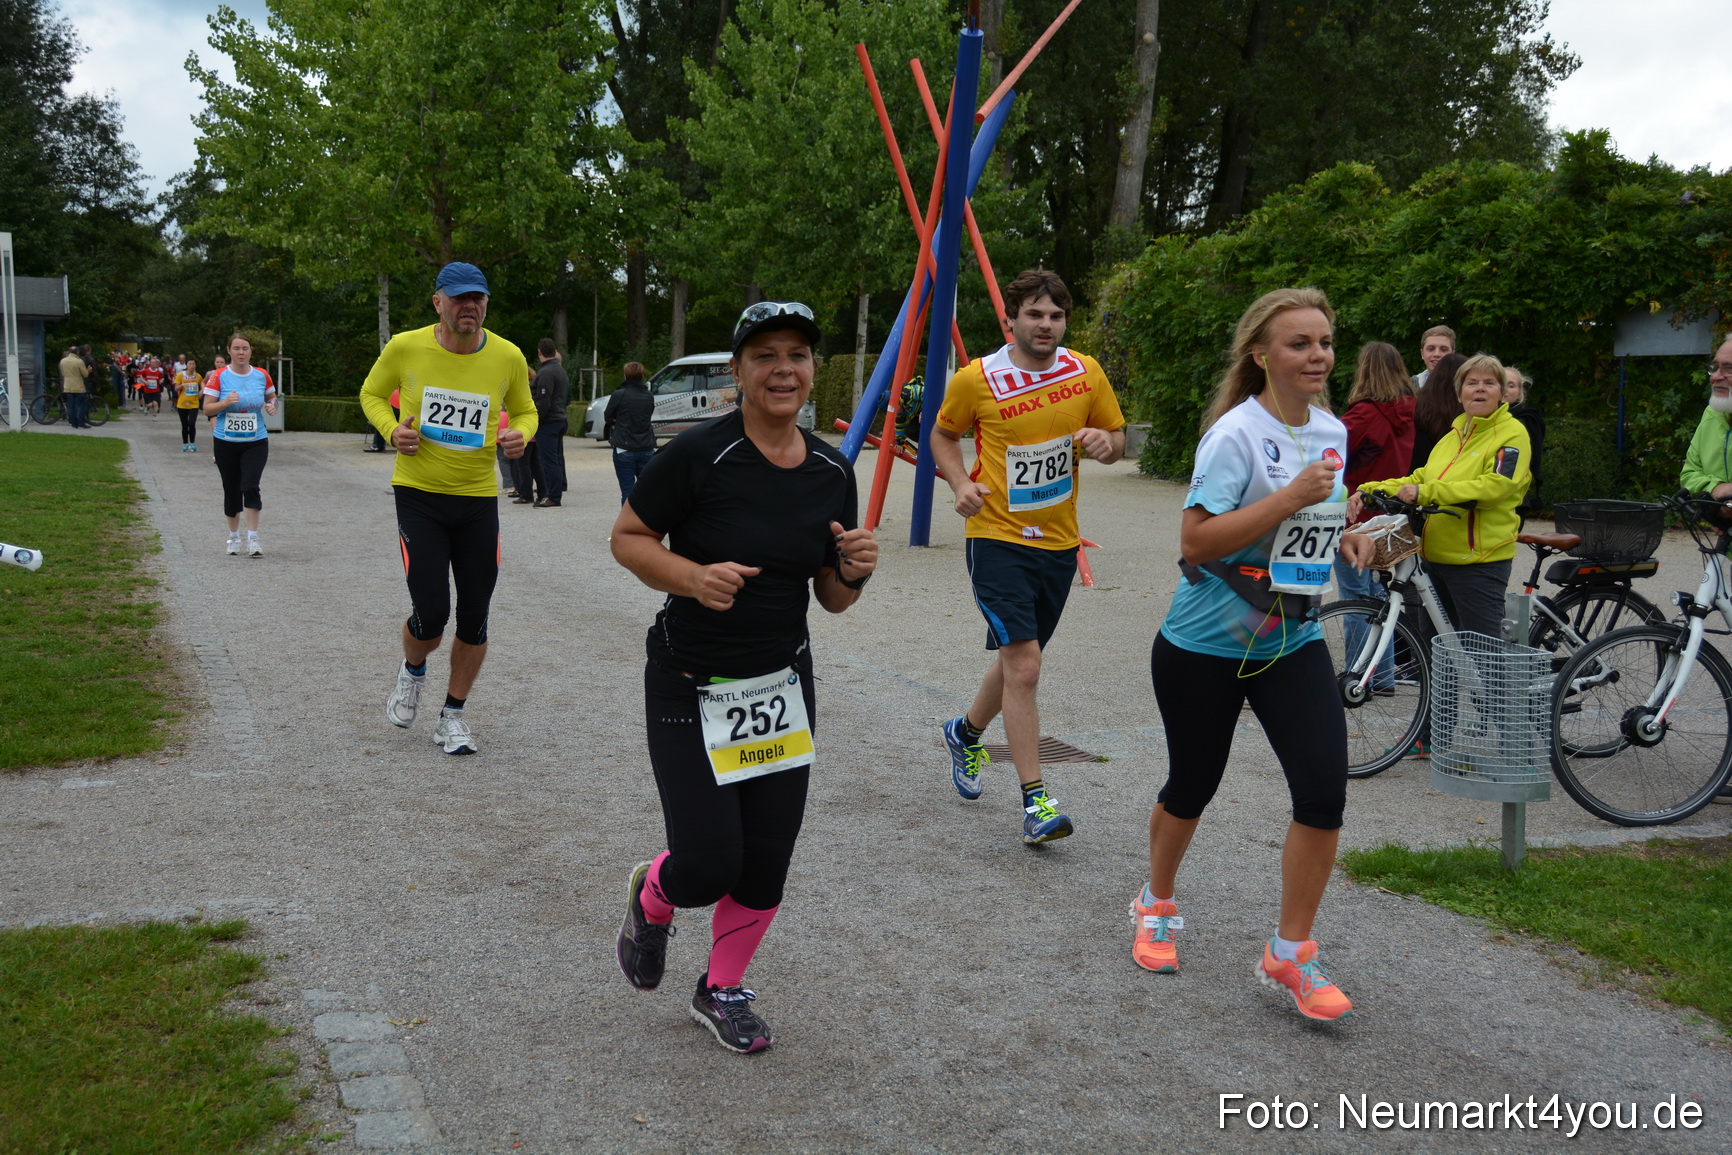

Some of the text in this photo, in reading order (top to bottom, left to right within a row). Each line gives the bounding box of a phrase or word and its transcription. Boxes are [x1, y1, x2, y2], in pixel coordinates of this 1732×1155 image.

[425, 391, 480, 406] PARTL Neumarkt
[999, 380, 1092, 421] MAX BÖGL
[428, 402, 482, 430] 2214
[227, 419, 254, 431] 2589
[442, 431, 463, 443] Hans
[1033, 443, 1063, 457] Neumarkt
[1015, 452, 1068, 485] 2782
[1267, 465, 1288, 475] PARTL
[1031, 487, 1058, 501] Marco
[1286, 512, 1345, 522] ARTL Neumarkt
[1297, 567, 1329, 581] Denis
[702, 680, 786, 703] PARTL Neumarkt
[726, 695, 790, 742] 252
[739, 744, 785, 764] Angela
